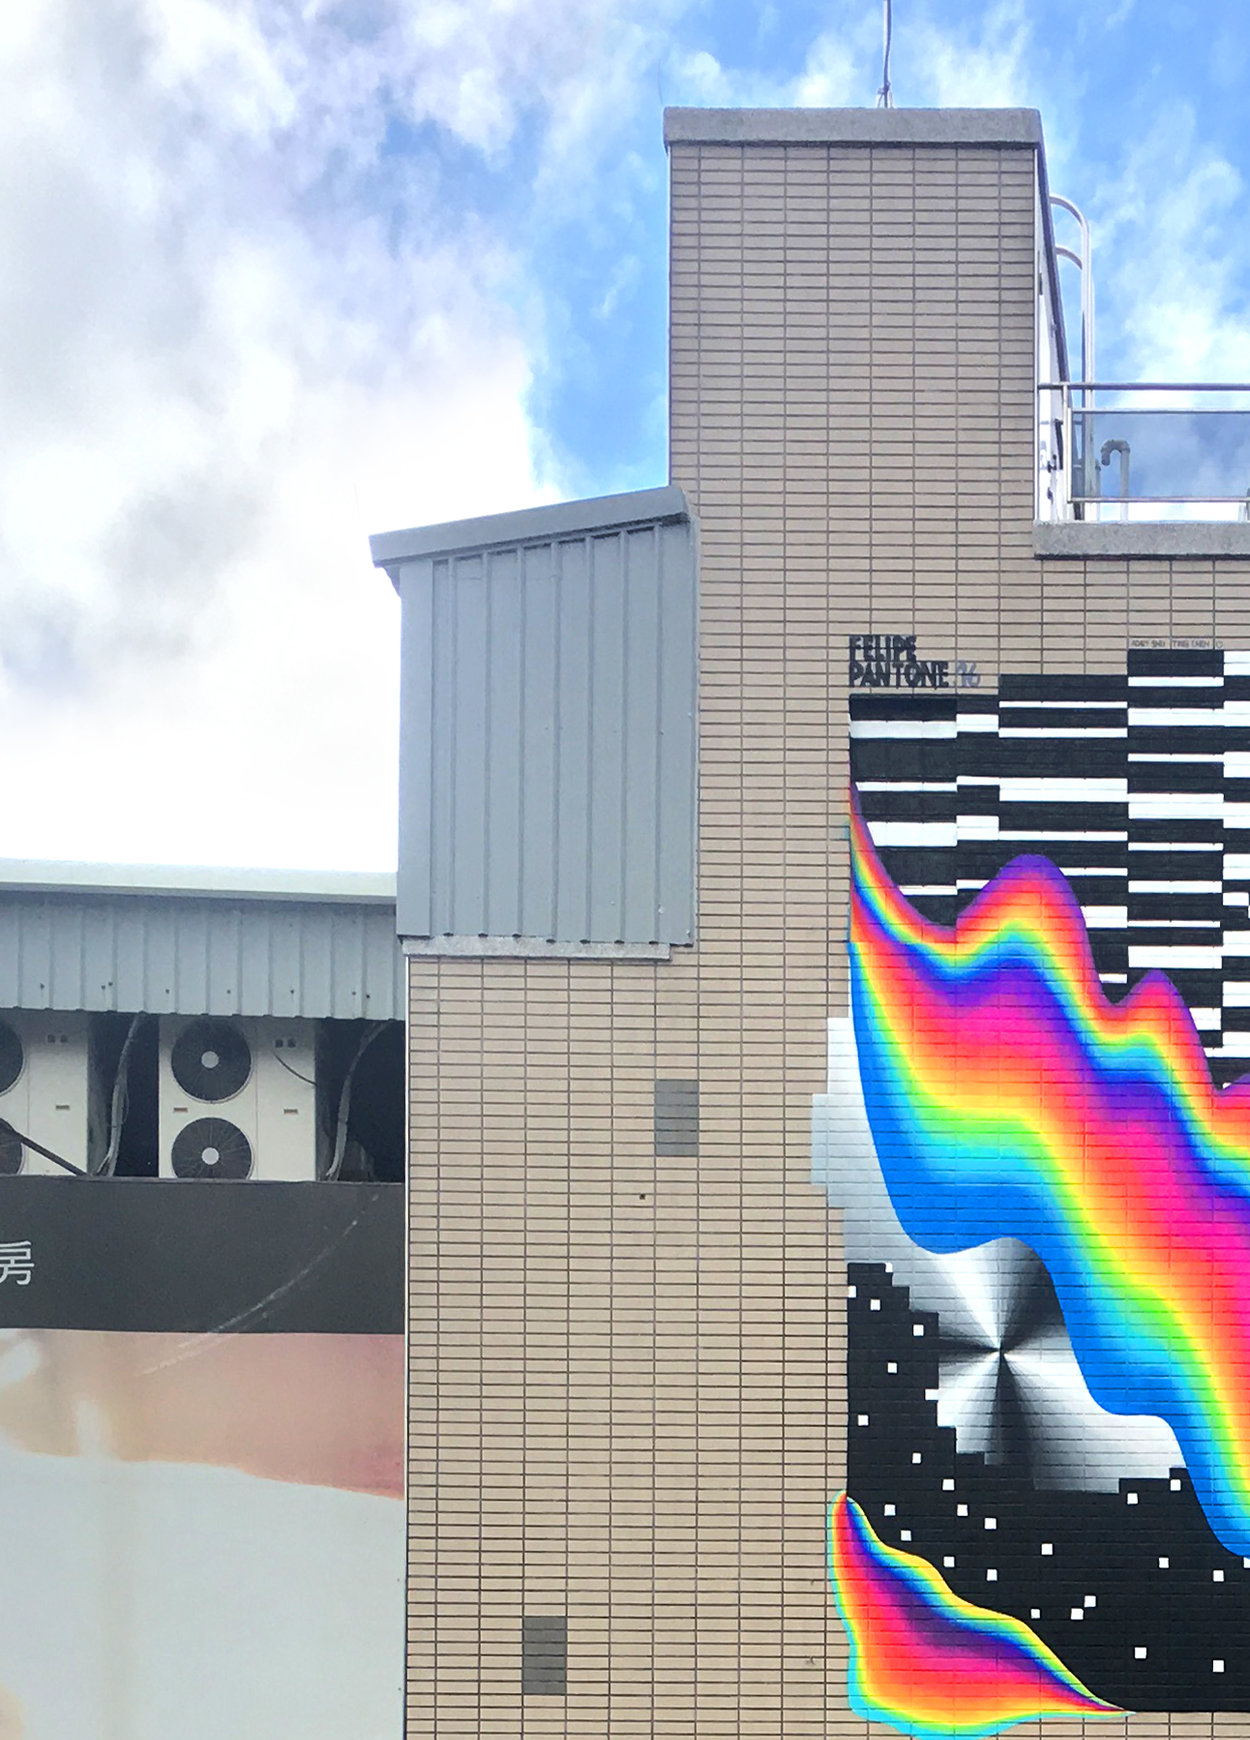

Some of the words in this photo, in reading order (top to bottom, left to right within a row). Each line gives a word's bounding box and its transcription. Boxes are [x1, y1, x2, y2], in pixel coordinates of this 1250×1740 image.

[849, 635, 916, 661] FELIPE
[849, 661, 949, 688] PANTONE
[0, 1240, 35, 1285] 房
